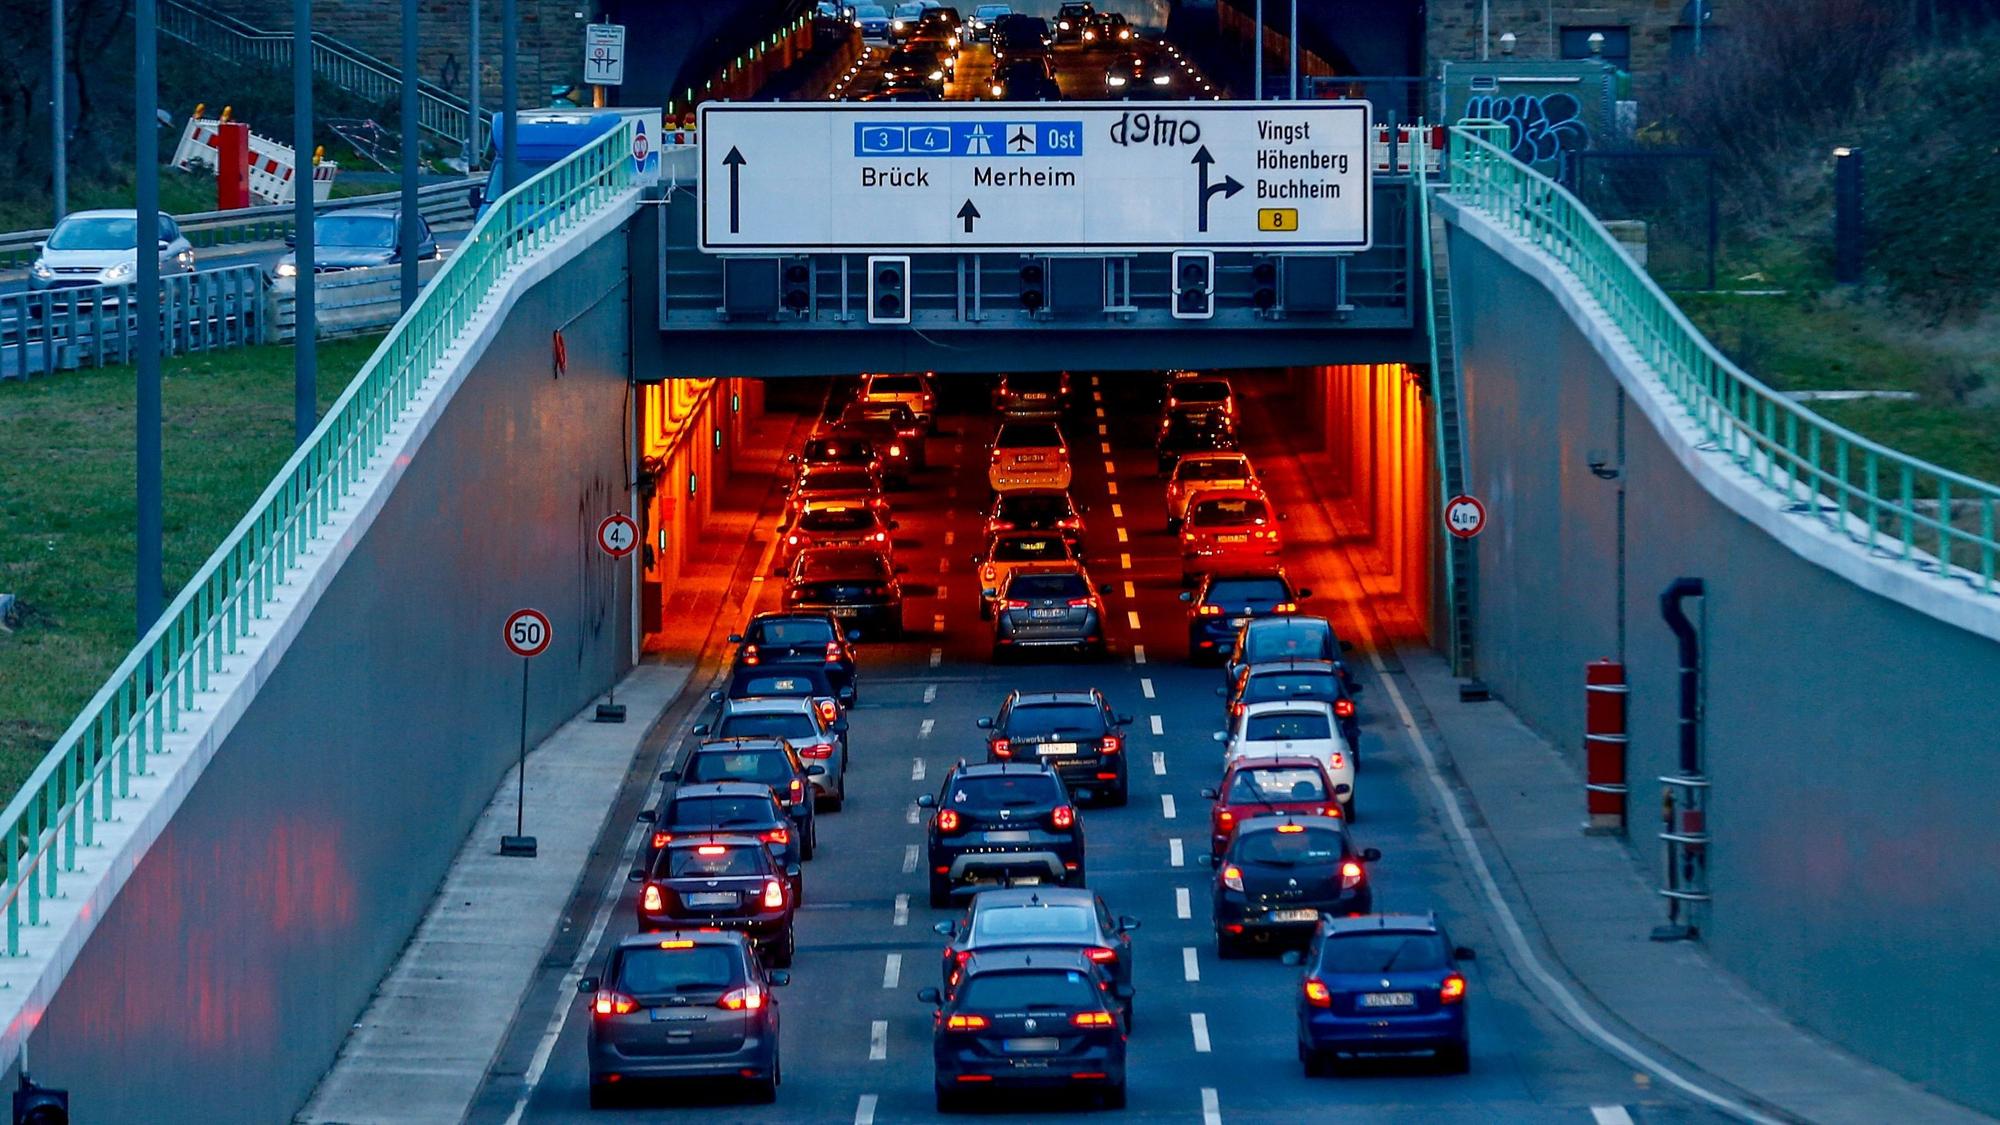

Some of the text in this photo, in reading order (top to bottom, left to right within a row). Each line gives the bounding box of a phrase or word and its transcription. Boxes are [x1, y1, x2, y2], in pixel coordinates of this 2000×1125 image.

[879, 129, 1075, 149] 3 4 Ost
[1257, 120, 1310, 144] Vingst
[1257, 150, 1348, 174] Höhenberg
[862, 167, 1075, 187] Brück Merheim
[1257, 179, 1341, 199] Buchheim
[1273, 212, 1283, 227] 8
[610, 529, 619, 543] 4
[514, 623, 540, 644] 50
